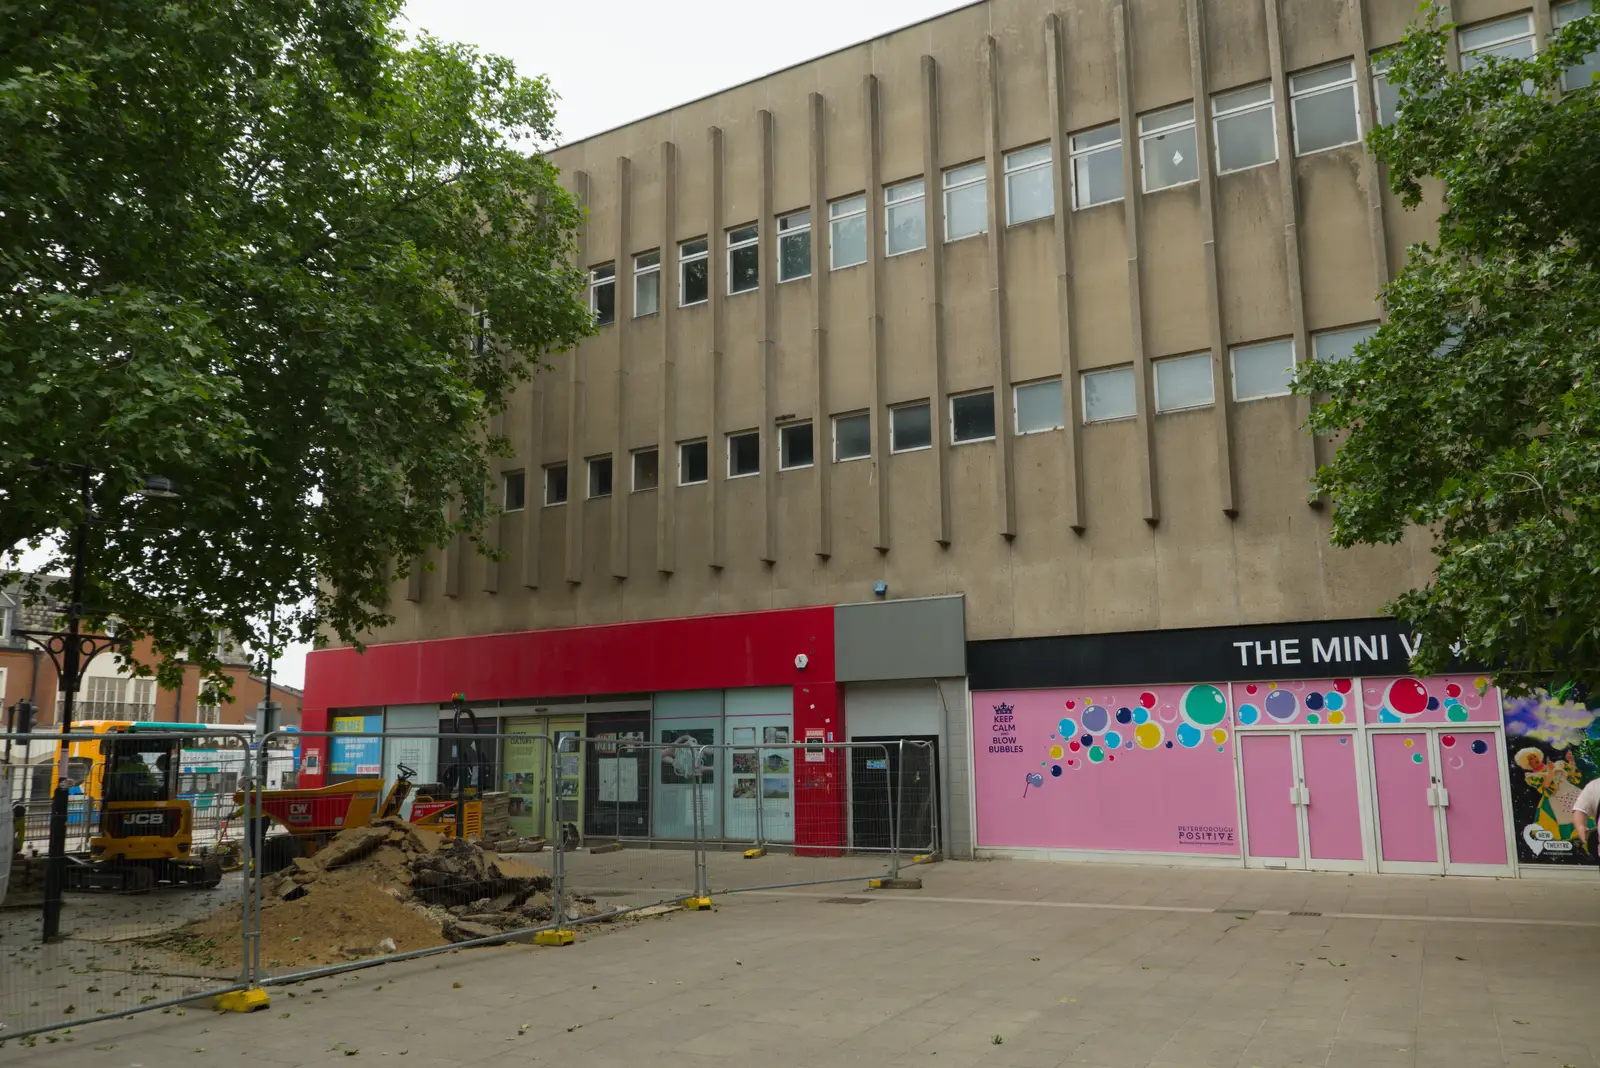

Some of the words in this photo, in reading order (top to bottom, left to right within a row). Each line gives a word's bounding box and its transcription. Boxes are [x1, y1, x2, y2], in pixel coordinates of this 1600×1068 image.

[1233, 639, 1301, 666] THE
[1312, 634, 1389, 663] MINI
[993, 715, 1014, 723] KEEP
[992, 724, 1016, 732] CALM
[992, 736, 1017, 744] BLOW
[988, 745, 1024, 753] BUBBLES
[123, 813, 164, 825] JCB
[1177, 825, 1234, 833] PETERBOROUGH
[1178, 832, 1234, 841] POSITIVE
